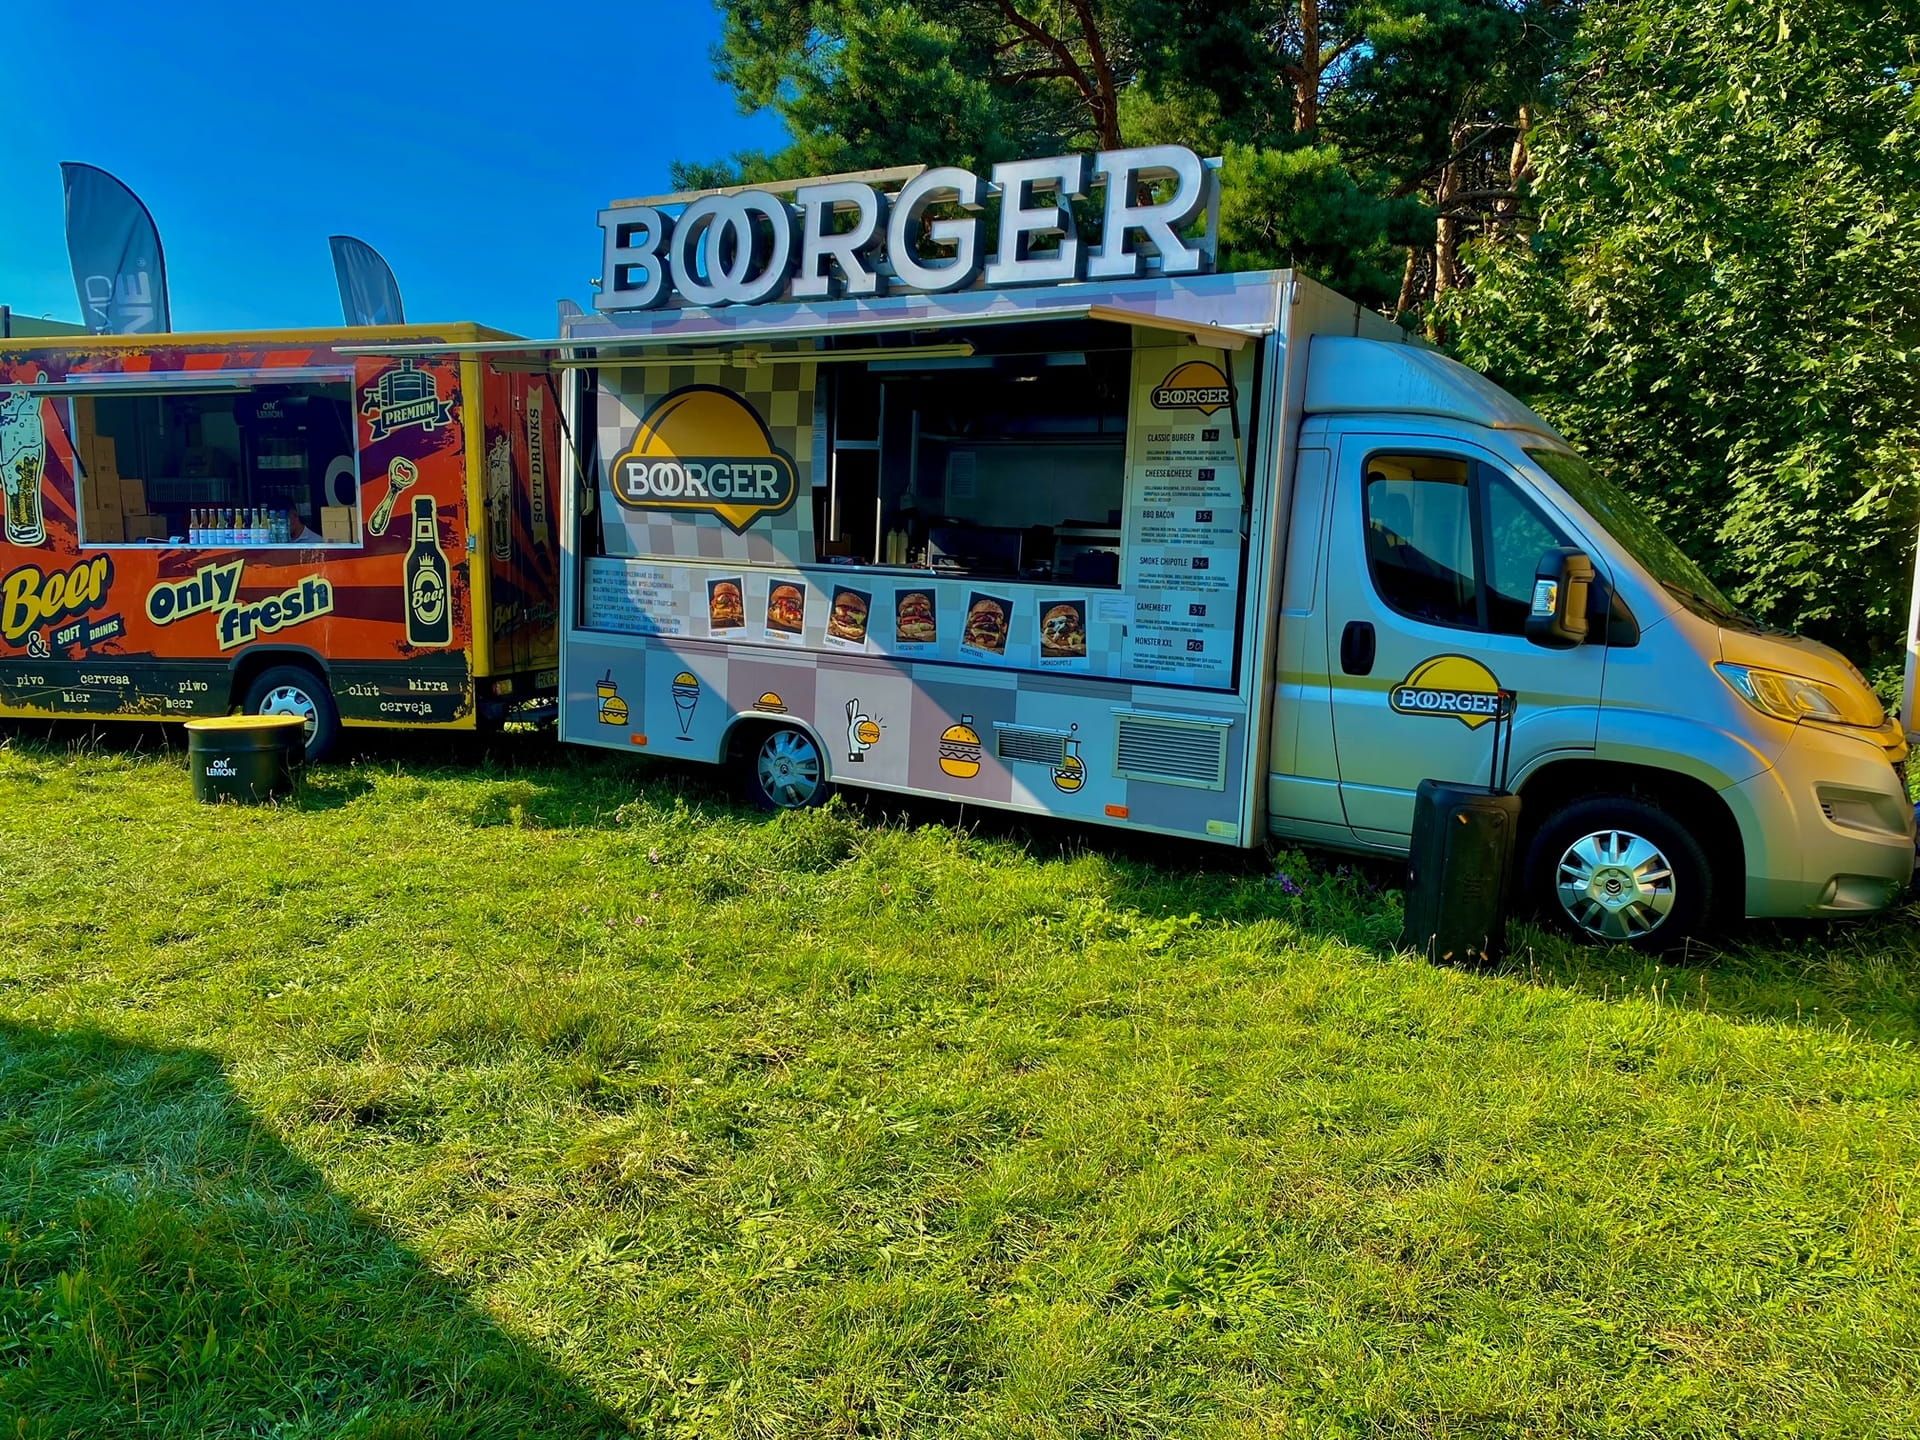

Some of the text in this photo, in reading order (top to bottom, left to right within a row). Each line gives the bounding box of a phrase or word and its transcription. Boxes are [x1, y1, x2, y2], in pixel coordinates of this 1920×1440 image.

[591, 144, 1208, 310] BOORGER
[1158, 389, 1230, 404] BOORGER
[385, 401, 435, 425] PREMIUM
[1147, 432, 1171, 442] CLASSIC
[1171, 433, 1195, 442] BURGER
[529, 408, 544, 523] SOFT DRINKS
[1145, 469, 1193, 478] CHEESE&CHEESE
[626, 462, 780, 499] BOORGER
[1142, 510, 1155, 519] BBQ
[1156, 510, 1176, 519] BACON
[1139, 556, 1159, 566] SMOKE
[1160, 557, 1188, 567] CHIPOTLE
[1, 556, 109, 640] Beer
[148, 563, 240, 622] only
[412, 588, 445, 609] Beer
[219, 576, 331, 646] fresh
[1136, 602, 1172, 612] CAMEMBERT
[57, 624, 81, 644] SOFT
[89, 620, 119, 640] DRINKS
[1135, 636, 1161, 646] MONSTER
[1161, 638, 1173, 647] XXL
[16, 674, 45, 686] pivo
[80, 673, 131, 685] cervesa
[407, 678, 449, 692] birra
[179, 680, 209, 693] piwo
[349, 684, 380, 696] olut
[62, 691, 91, 703] bier
[164, 696, 194, 709] beer
[379, 701, 433, 716] cerveja
[213, 757, 231, 768] ON
[206, 766, 236, 776] LEMON
